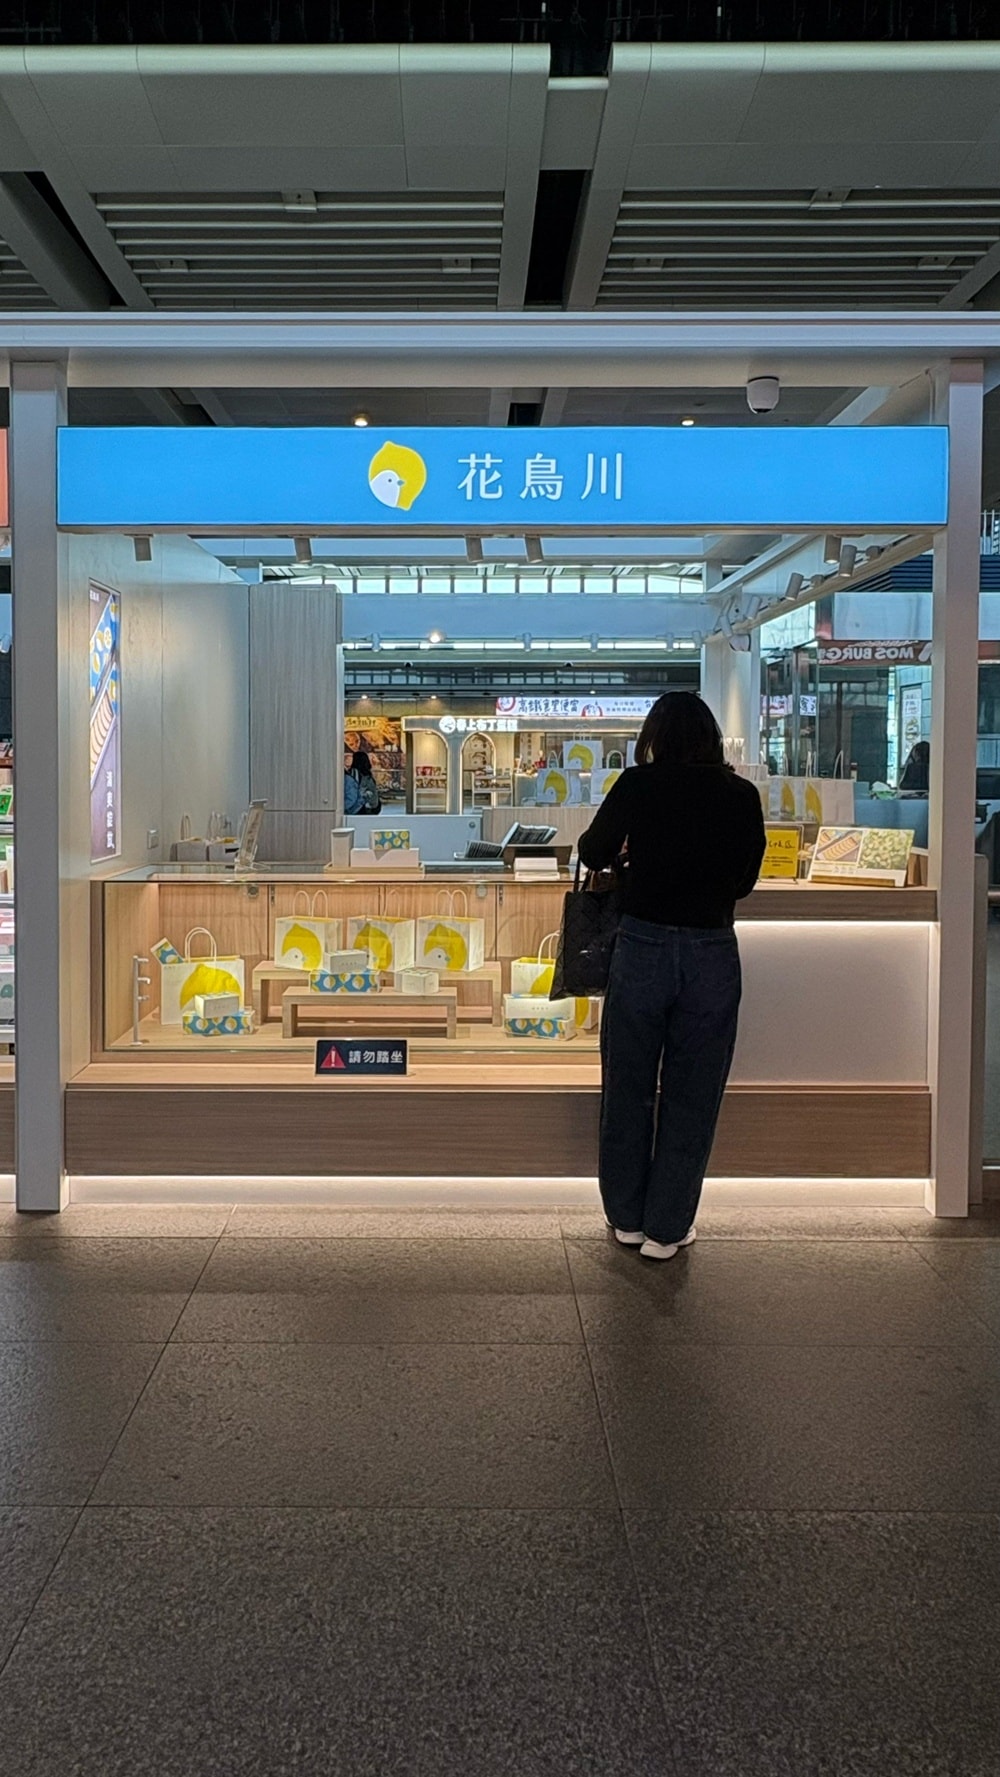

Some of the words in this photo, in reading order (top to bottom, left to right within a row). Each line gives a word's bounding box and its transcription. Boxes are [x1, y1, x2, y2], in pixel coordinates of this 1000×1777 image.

[457, 453, 622, 500] 花鳥川
[348, 1050, 404, 1064] 請勿踏坐
